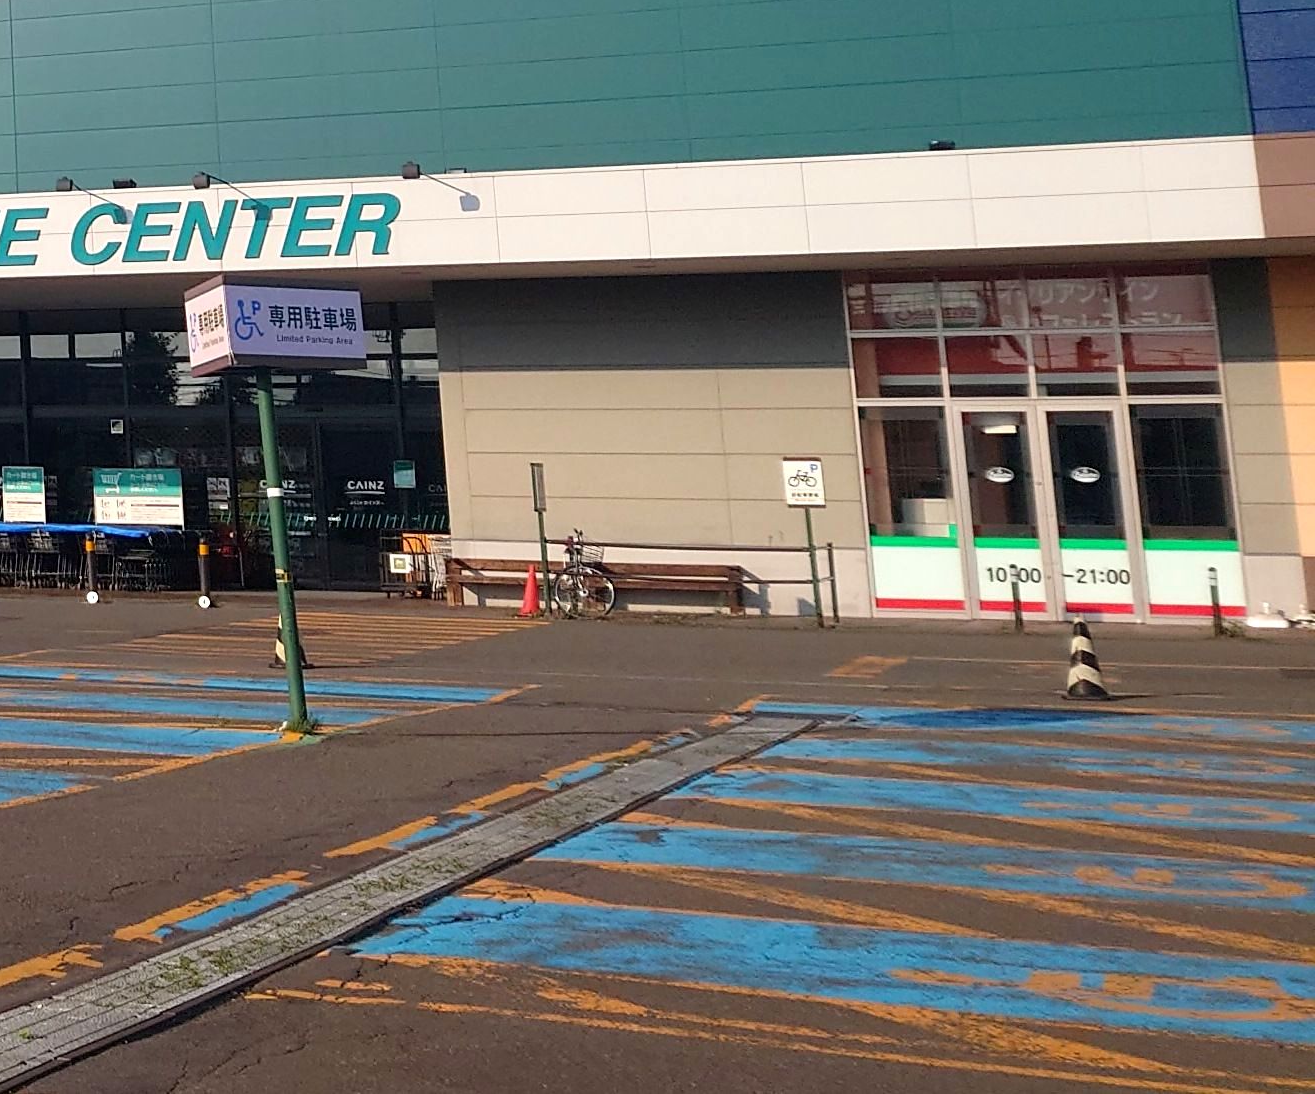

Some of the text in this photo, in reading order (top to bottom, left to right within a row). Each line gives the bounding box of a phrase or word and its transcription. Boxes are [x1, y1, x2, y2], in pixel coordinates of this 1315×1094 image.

[70, 192, 401, 266] CENTER
[268, 305, 357, 332] 専用駐車場
[277, 335, 353, 345] Limited Parking Area
[259, 480, 296, 489] CNZ
[347, 480, 385, 490] CAINZ
[986, 567, 1042, 583] 1000
